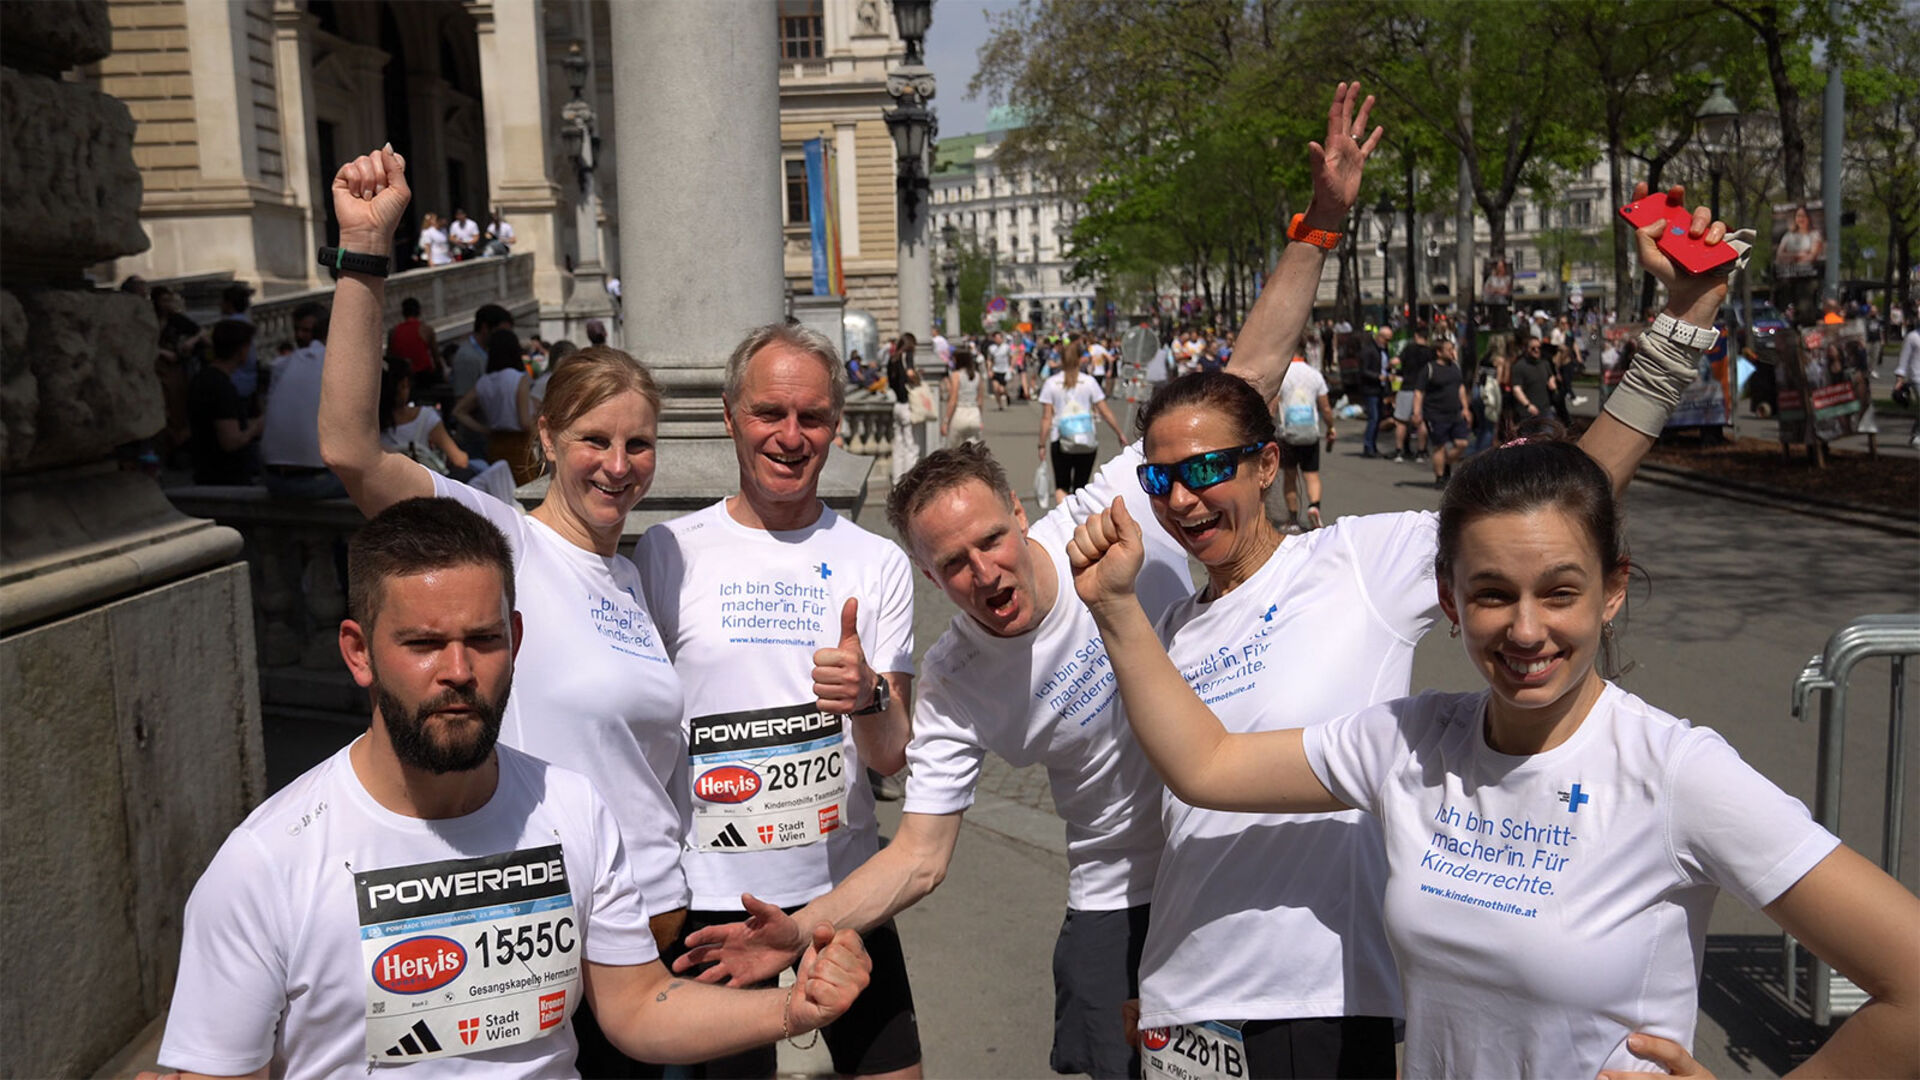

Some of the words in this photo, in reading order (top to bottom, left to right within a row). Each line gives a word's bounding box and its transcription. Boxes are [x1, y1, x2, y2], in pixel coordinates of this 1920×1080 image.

[720, 582, 741, 596] Ich
[746, 581, 770, 594] bin
[774, 581, 829, 599] Schritt-
[802, 600, 826, 616] Für
[721, 615, 824, 632] Kinderrechte.
[729, 636, 815, 647] www.kindernothilfe.at
[1035, 680, 1058, 699] Ich
[1054, 661, 1078, 682] bin
[1075, 637, 1104, 663] Sch
[1059, 671, 1115, 720] Kinderre
[1080, 688, 1119, 727] www.kindern
[695, 711, 836, 745] POWERADE
[701, 775, 756, 796] Hervis
[767, 751, 842, 791] 2872C
[764, 796, 813, 810] Kindernothilfe
[778, 821, 805, 833] Stadt
[779, 831, 806, 842] Wien
[1435, 803, 1460, 827] Ich
[1466, 812, 1494, 836] bin
[1500, 818, 1577, 846] Schritt-
[1421, 849, 1554, 896] Kinderrechte.
[1532, 849, 1569, 872] Für
[368, 858, 564, 909] POWERADE
[1420, 883, 1537, 918] www.kindernothilfe.at
[475, 917, 576, 969] 1555C
[382, 948, 460, 981] Hervis
[469, 974, 542, 996] Gesangskapelle
[544, 966, 578, 982] Hermann
[486, 1010, 519, 1027] Stadt
[486, 1026, 520, 1040] Wien
[1173, 1025, 1243, 1078] 2281B
[1167, 1062, 1188, 1080] KPMG
